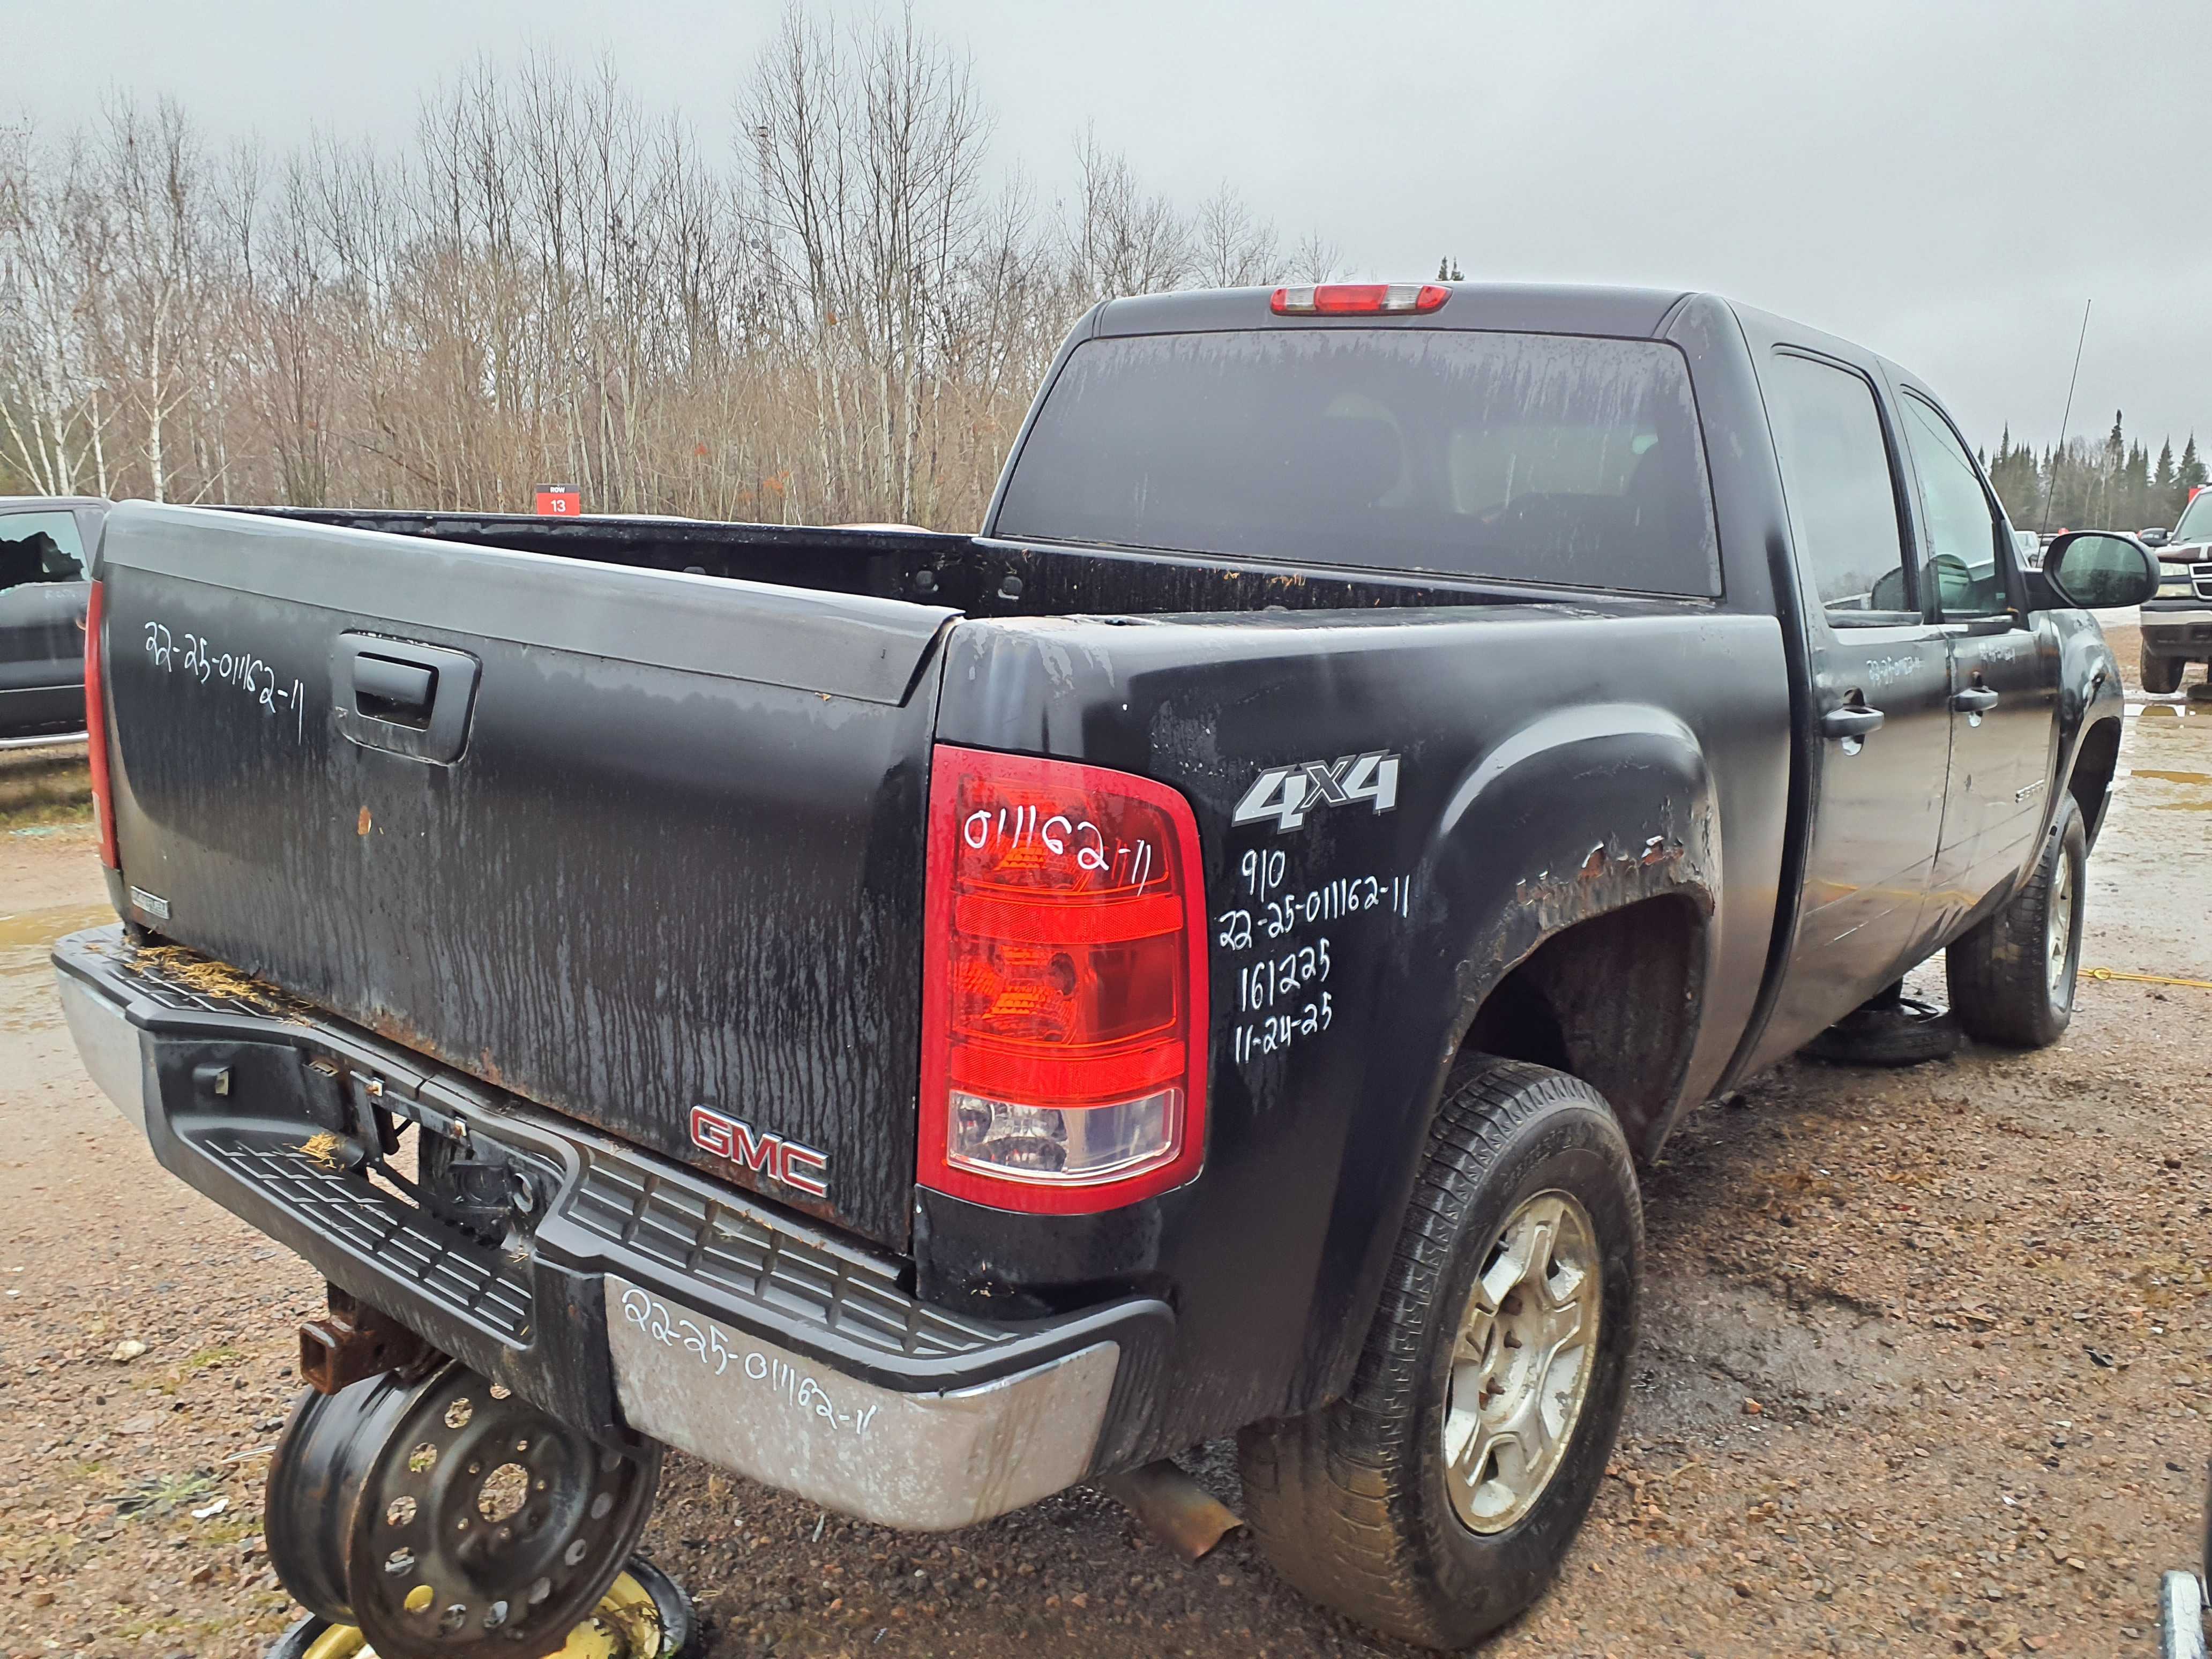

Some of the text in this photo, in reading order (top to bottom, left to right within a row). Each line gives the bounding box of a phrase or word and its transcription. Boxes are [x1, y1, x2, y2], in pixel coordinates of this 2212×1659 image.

[551, 499, 566, 512] 13
[145, 621, 303, 745] 22-25-011162-11
[965, 805, 1151, 897] 011162-11
[1242, 849, 1285, 902] 910
[1218, 875, 1410, 951] 22-25-011162-11
[1242, 938, 1330, 1012] 161225
[1235, 992, 1332, 1063] 11-24-25
[690, 1105, 829, 1198] GMC
[622, 1288, 877, 1435] 22-25-011162-11
